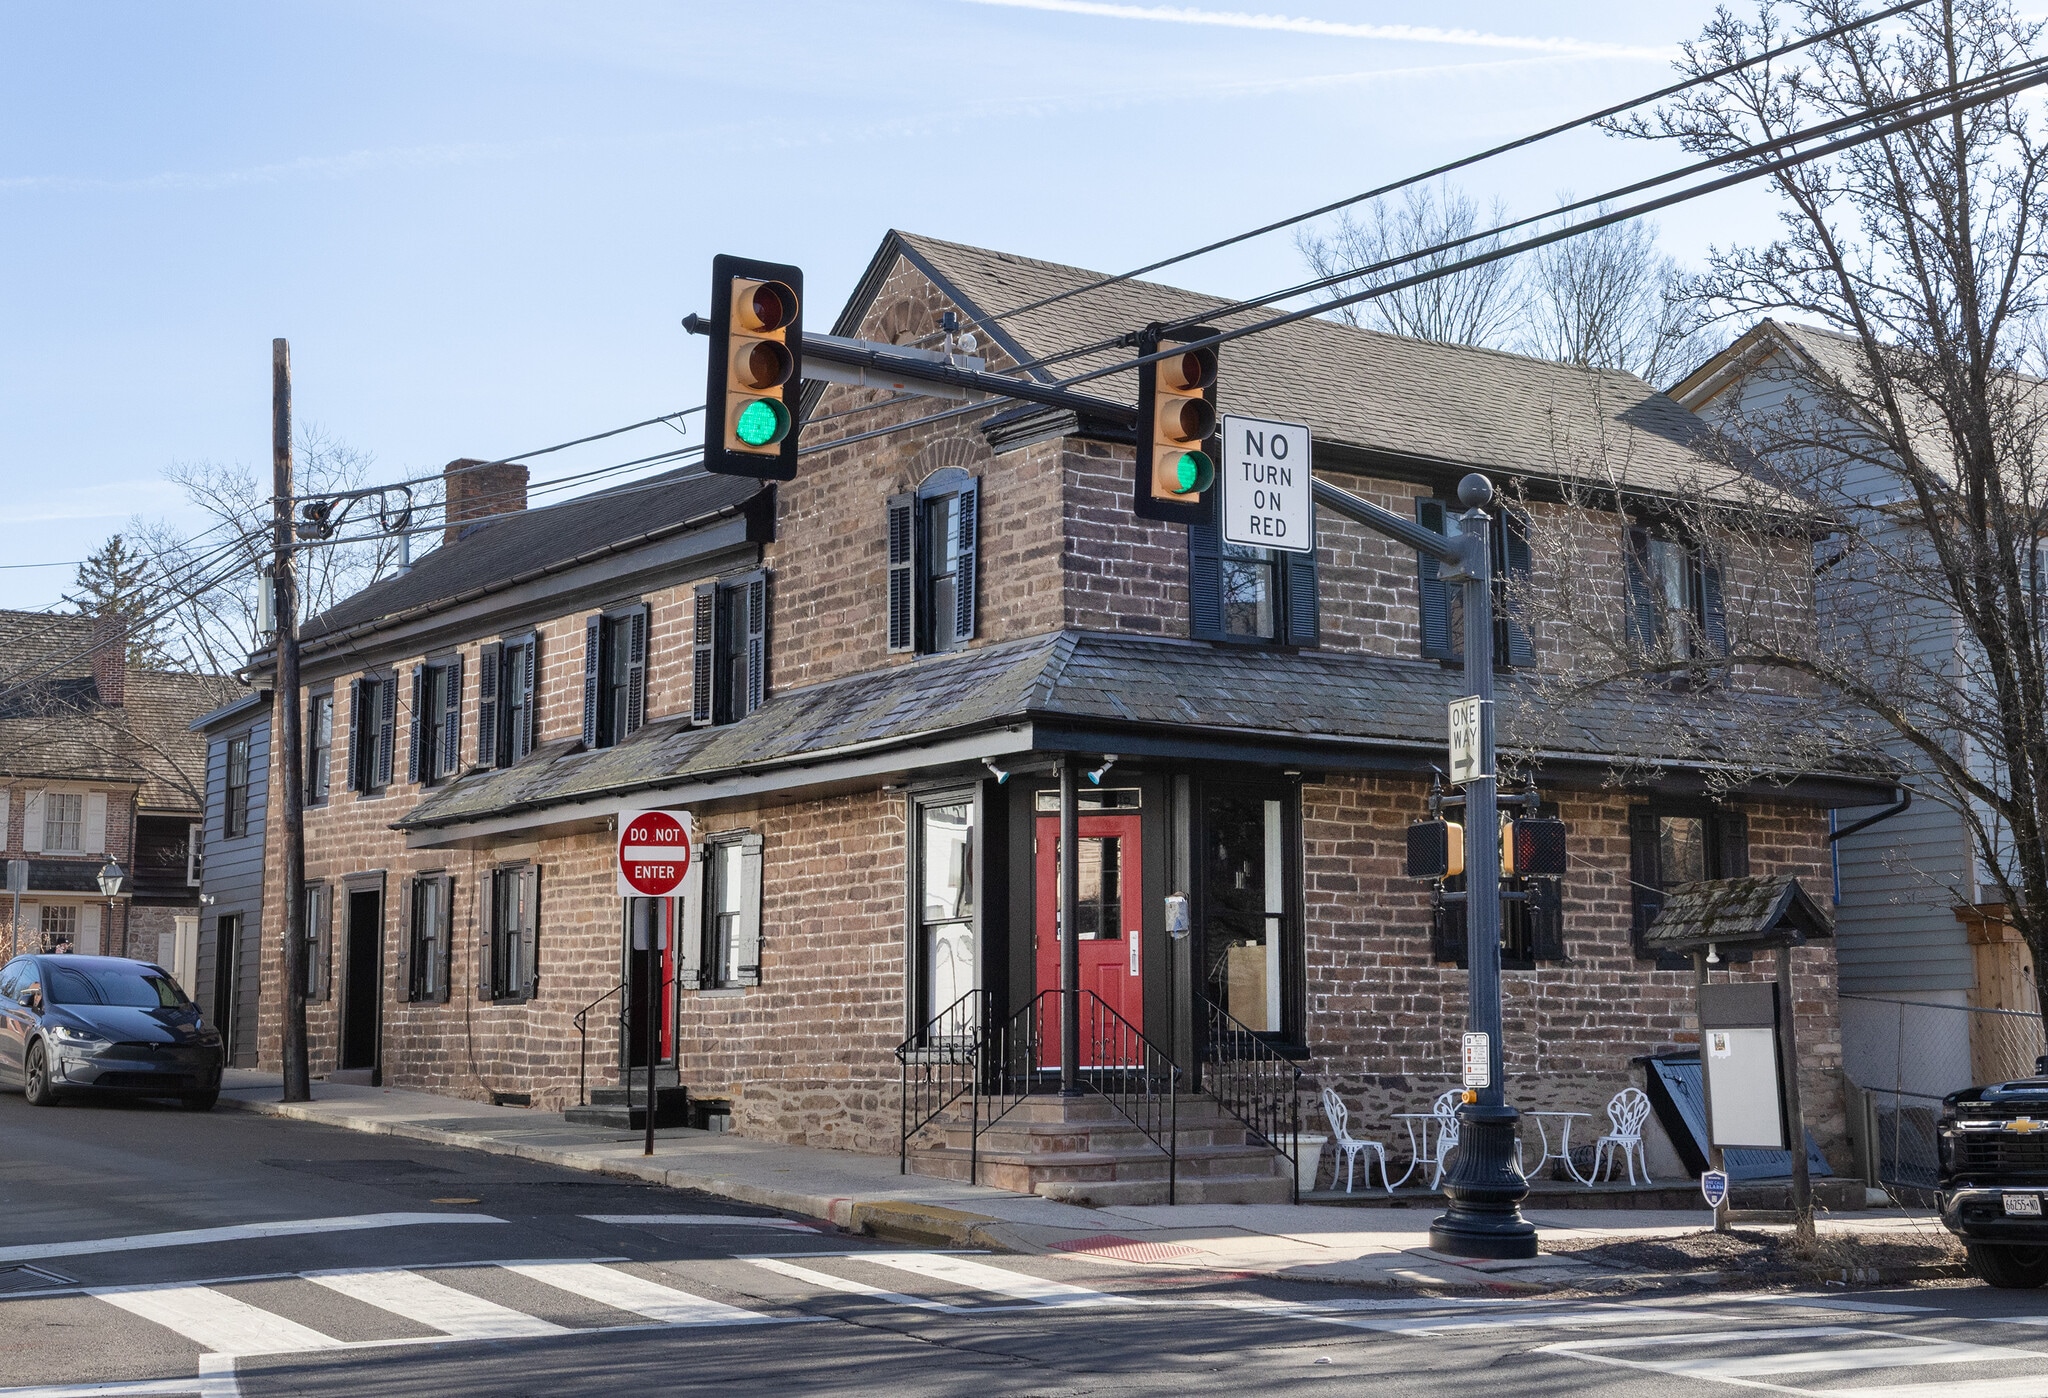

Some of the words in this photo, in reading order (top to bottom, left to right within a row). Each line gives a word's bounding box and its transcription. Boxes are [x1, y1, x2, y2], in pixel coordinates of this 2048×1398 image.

[1246, 429, 1289, 460] NO
[1242, 462, 1292, 487] TURN
[1254, 489, 1281, 512] ON
[1250, 515, 1287, 538] RED
[1452, 705, 1476, 727] ONE
[1453, 726, 1477, 750] WAY
[630, 828, 648, 842] DO
[655, 828, 680, 842] NOT
[634, 865, 675, 879] ENTER
